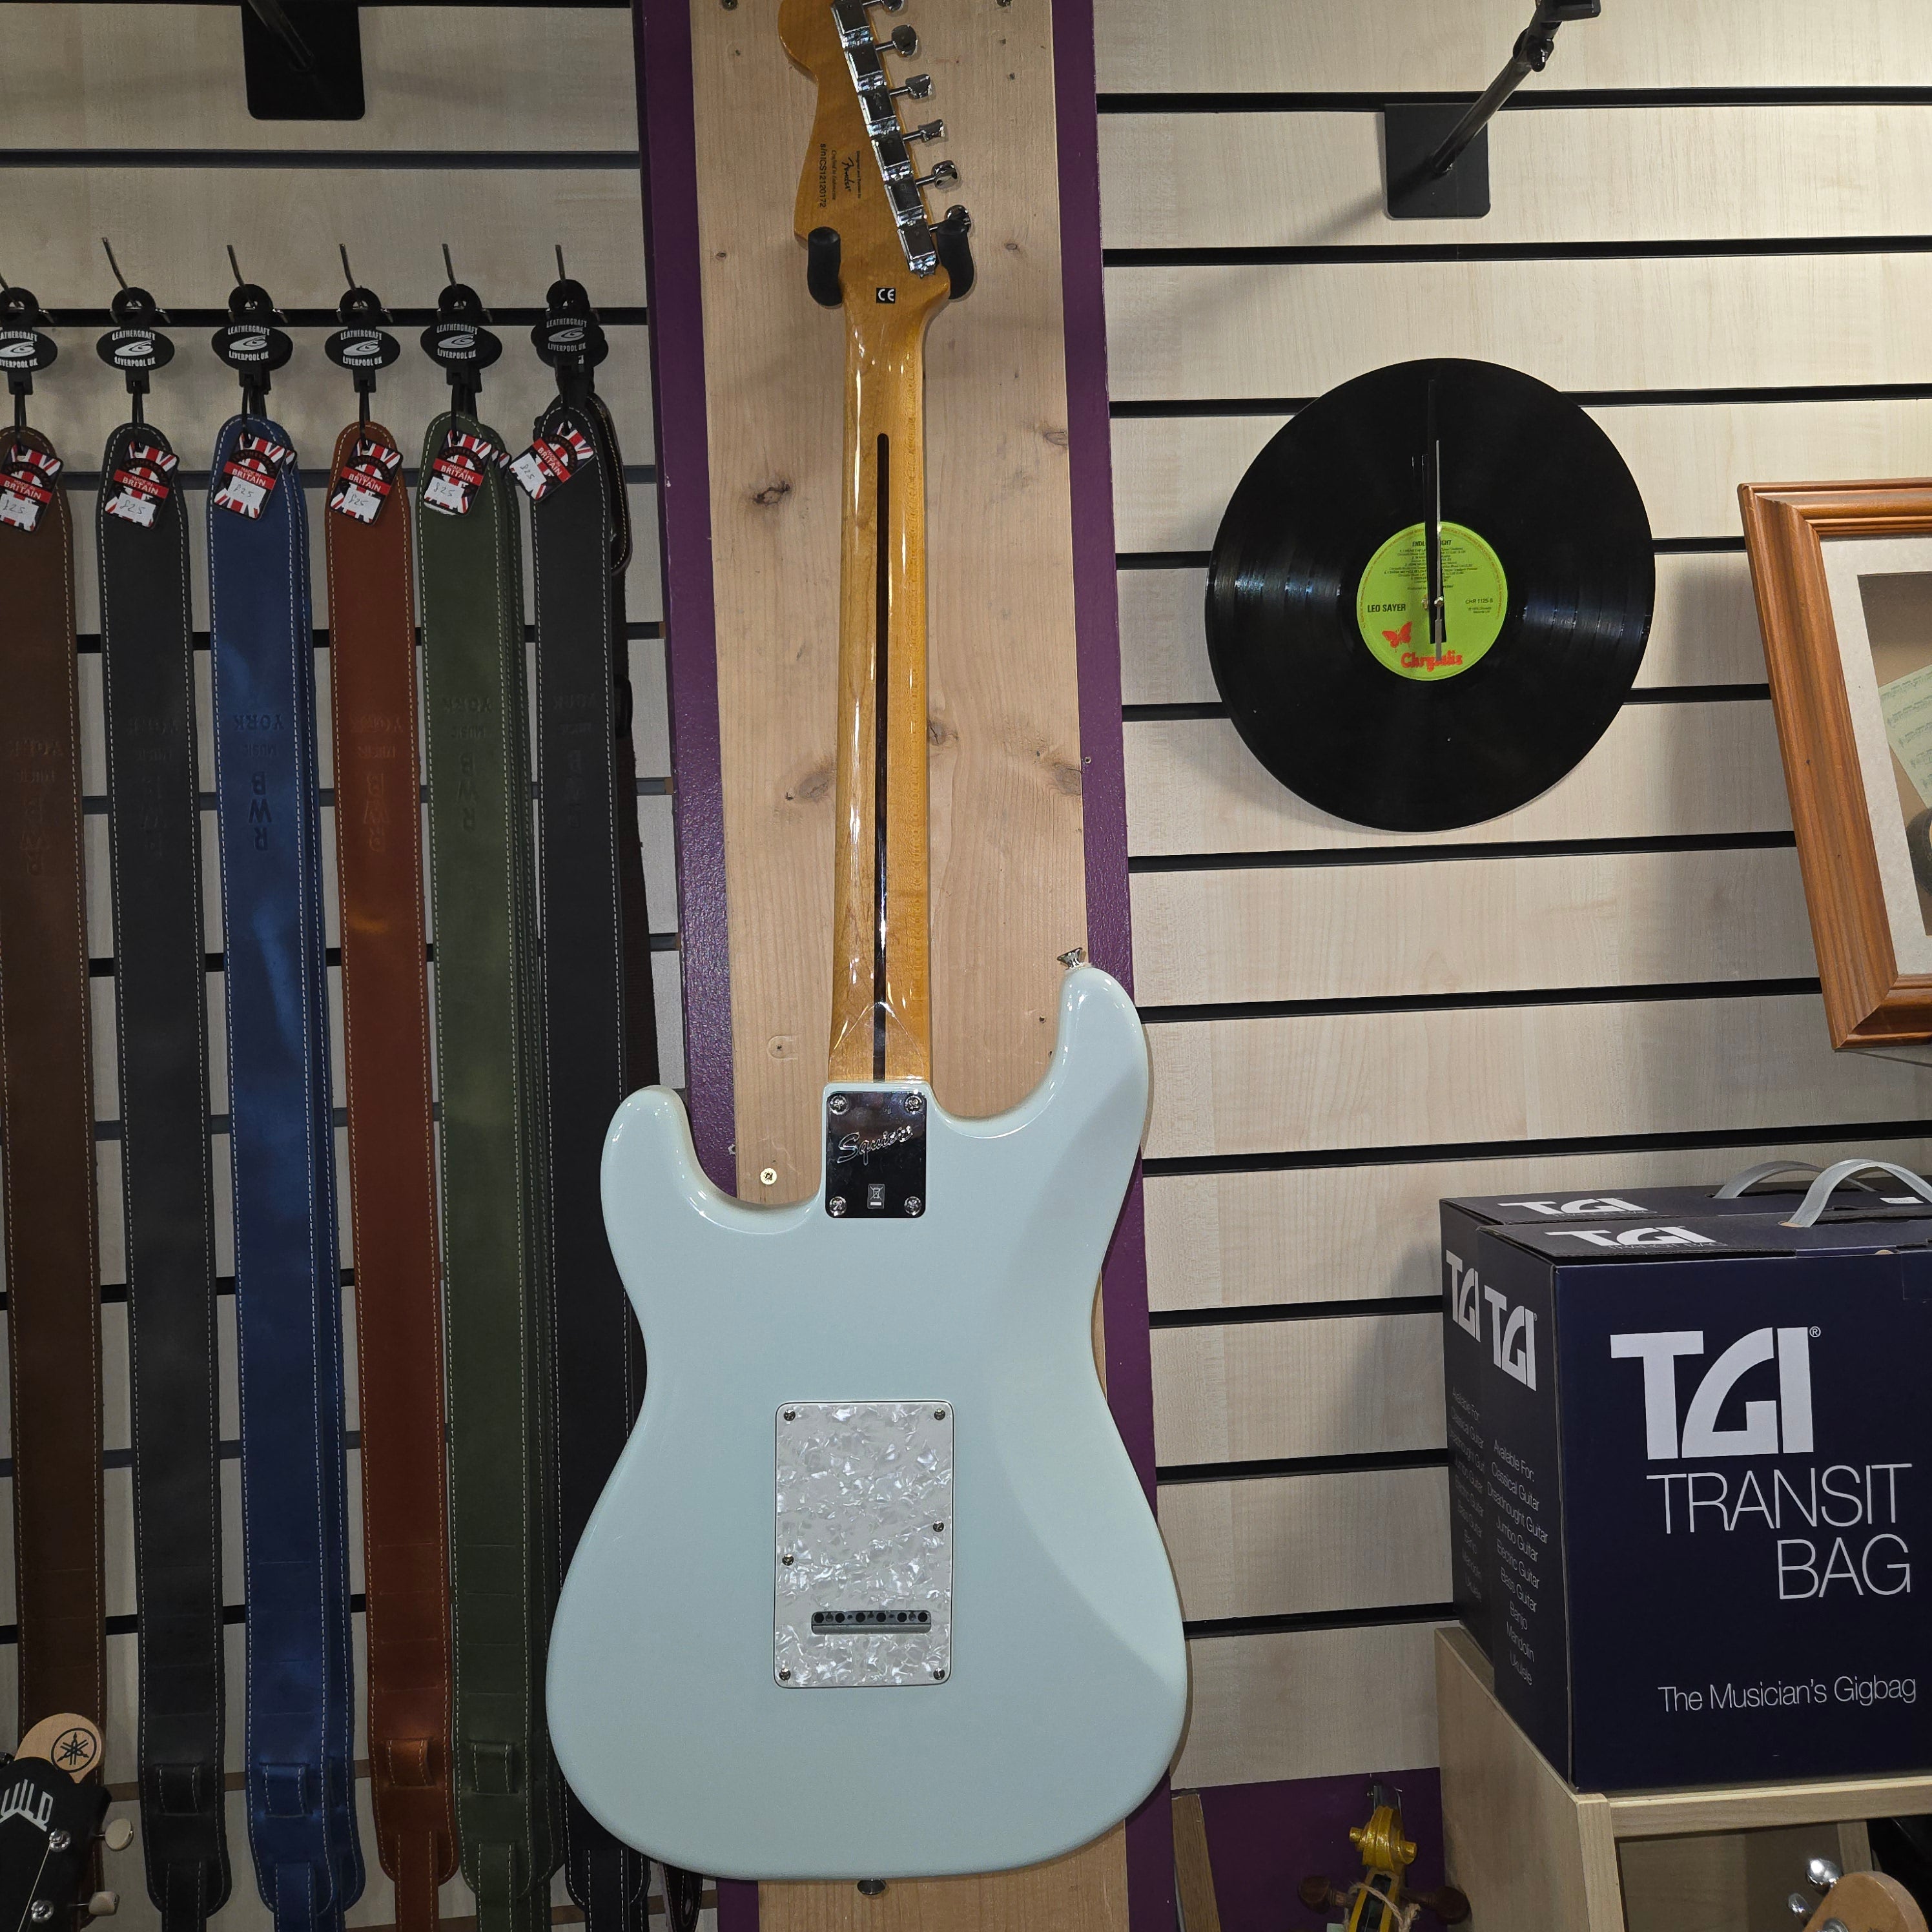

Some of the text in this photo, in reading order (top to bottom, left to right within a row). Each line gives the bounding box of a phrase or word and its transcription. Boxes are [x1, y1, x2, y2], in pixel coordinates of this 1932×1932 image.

[841, 156, 855, 189] Fender
[878, 289, 894, 302] CE
[229, 350, 269, 361] LIVERPOOL UK
[437, 348, 476, 359] LIVERPOOL UK
[547, 342, 586, 352] LIVERPOOL UK
[29, 358, 38, 367] UK
[114, 356, 156, 367] LIVERPOOL UK
[343, 356, 382, 366] LIVERPOOL UK
[537, 447, 563, 476] BRITAIN
[232, 468, 267, 486] BRITAIN
[349, 473, 382, 492] BRITAIN
[441, 465, 475, 483] BRITAIN
[3, 480, 42, 500] BRITAIN
[122, 477, 159, 495] BRITAIN
[233, 484, 254, 497] £25
[3, 499, 25, 514] £25
[119, 500, 145, 515] £25
[1367, 603, 1406, 613] LEO SAYER
[234, 714, 284, 730] YORK
[837, 1125, 914, 1166] Squier
[1497, 1197, 1649, 1215] TGI
[1545, 1226, 1717, 1247] TGI
[1446, 1249, 1481, 1342] TGI
[1484, 1284, 1537, 1392] TGI
[1610, 1326, 1814, 1461] TGI
[1494, 1439, 1520, 1471] Available
[1492, 1462, 1540, 1512] Classical Guitar
[1647, 1463, 1913, 1534] TRANSIT
[1487, 1481, 1548, 1544] Dreadnought Guitar
[1496, 1516, 1539, 1562] Jumbo Guitar
[1497, 1538, 1540, 1588] Electric Guitar
[1777, 1534, 1911, 1599] BAG
[1501, 1567, 1537, 1612] Bass Guitar
[1510, 1601, 1528, 1630] Banjo
[1506, 1621, 1534, 1663] Mandolin
[1510, 1649, 1532, 1686] Ukulele
[1658, 1675, 1917, 1712] The Musician's Gigbag
